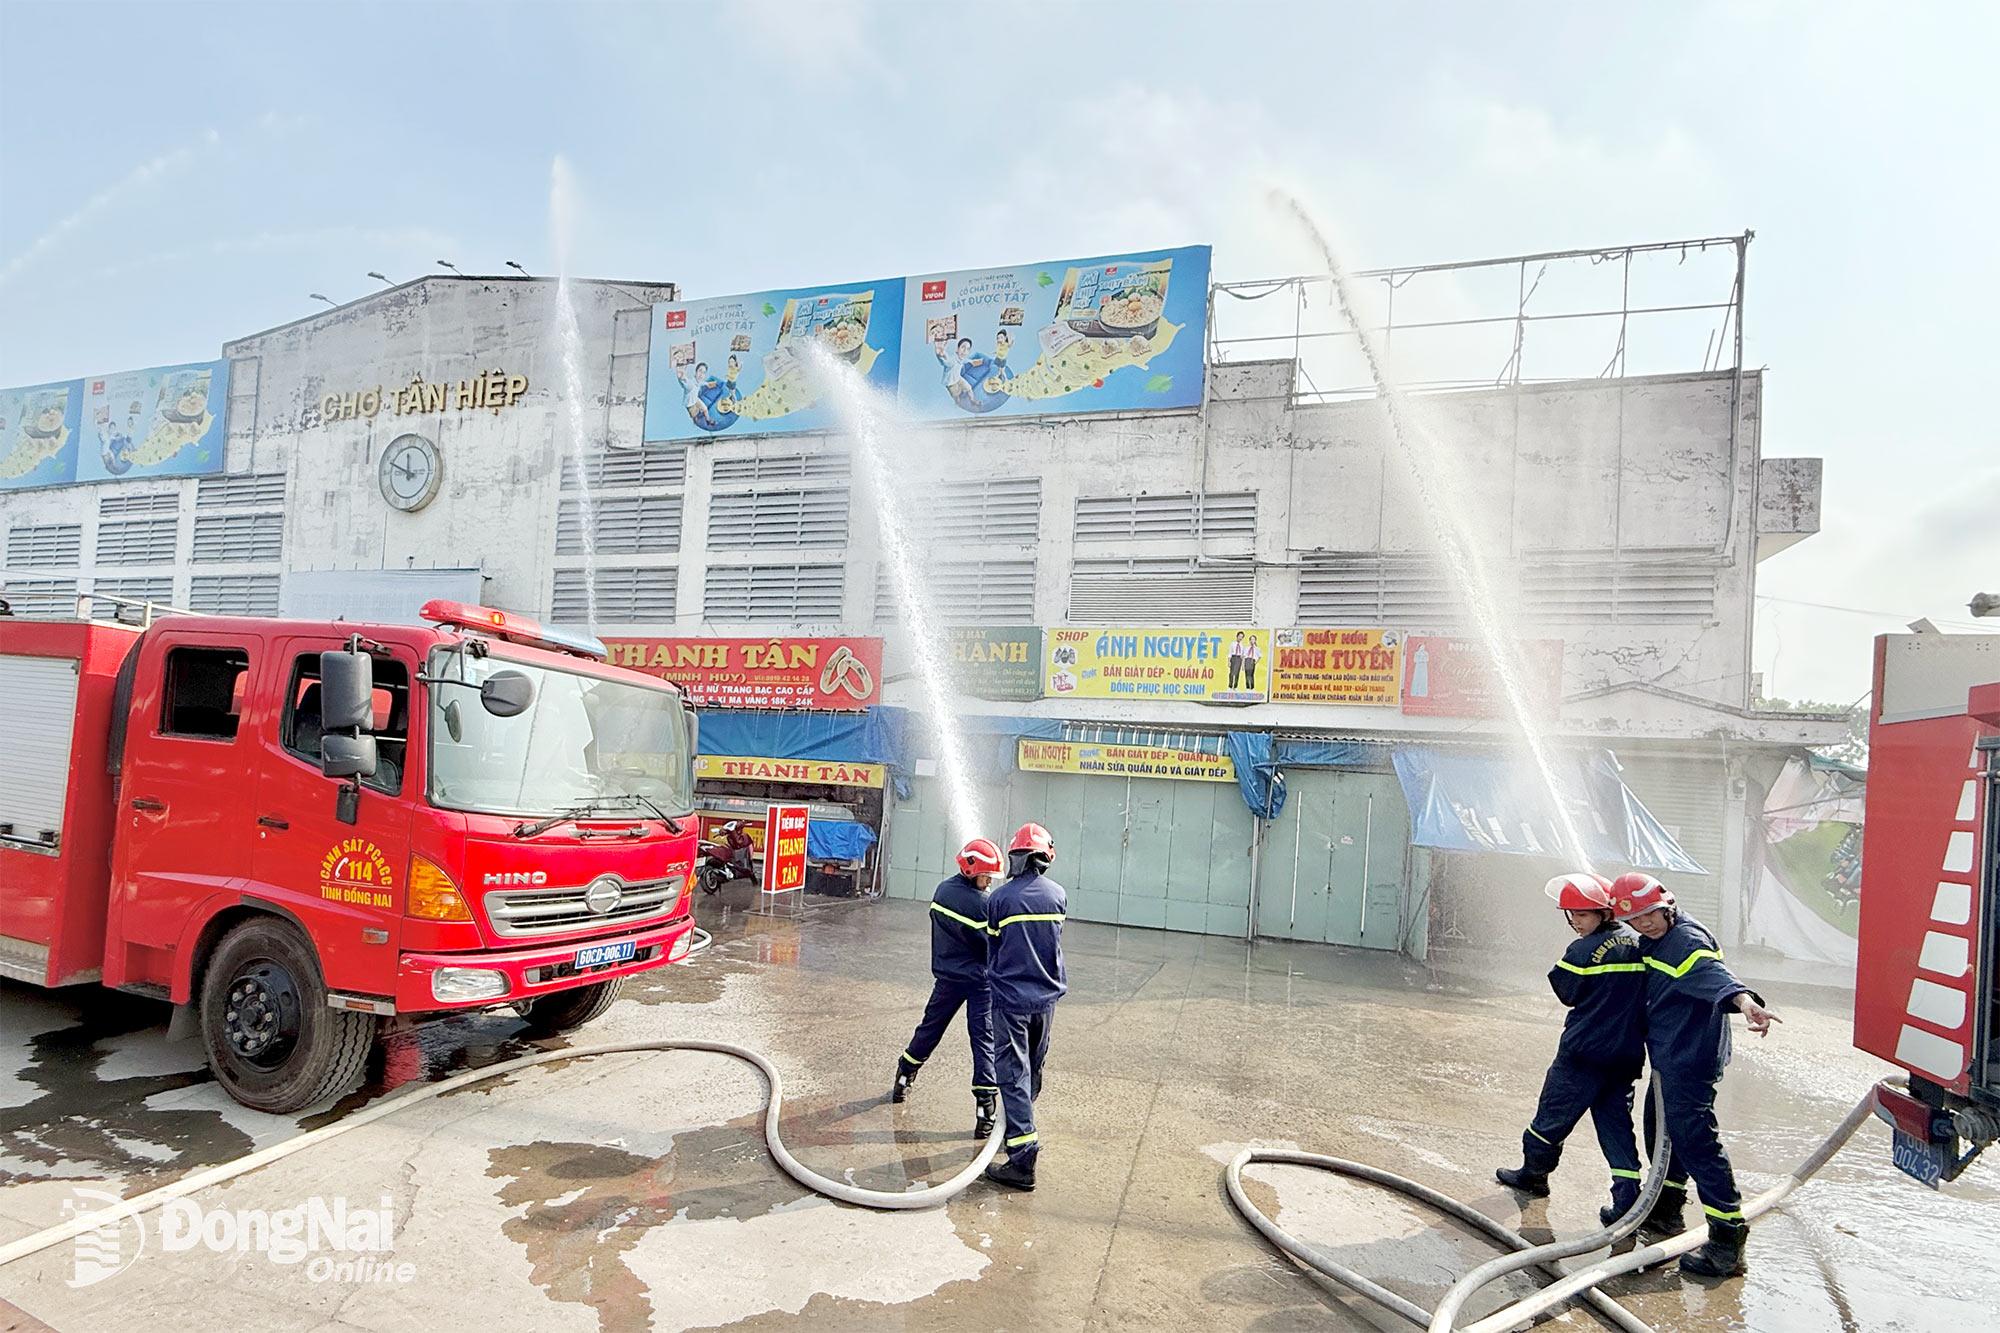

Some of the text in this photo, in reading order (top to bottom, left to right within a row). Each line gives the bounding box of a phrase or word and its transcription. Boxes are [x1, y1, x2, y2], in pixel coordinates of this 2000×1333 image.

[924, 292, 944, 300] VIFON
[391, 372, 447, 416] TÂN
[455, 367, 528, 416] HIỆP
[1056, 631, 1089, 641] SHOP
[604, 638, 820, 669] THANH TÂN
[1096, 631, 1222, 664] ÁNH NGUYỆT
[1280, 648, 1326, 669] MINH
[661, 672, 747, 684] (MINH HUY)
[1104, 664, 1122, 677] BÁN
[1124, 665, 1145, 678] GIÀY
[1147, 665, 1165, 678] DÉP
[1174, 664, 1199, 680] QUẦN
[1201, 666, 1214, 679] ÁO
[722, 686, 753, 694] TRANG
[775, 686, 794, 694] CAO
[1110, 679, 1205, 696] ĐỒNG PHỤC HỌC SINH
[744, 694, 770, 704] VÀNG
[771, 696, 786, 705] 18K
[795, 697, 814, 706] 24K
[1106, 748, 1124, 758] BÁN
[1150, 748, 1168, 761] DÉP
[722, 761, 810, 779] THANH
[817, 764, 871, 784] TÂN
[1080, 760, 1104, 773] NHẬN
[1155, 762, 1166, 775] ÁO
[1170, 763, 1182, 776] VÀ
[1184, 764, 1206, 777] GIÀY
[1208, 764, 1227, 778] DÉP
[779, 838, 805, 856] THANH
[320, 836, 392, 886] CẢNH SÁT PC&CC
[348, 860, 373, 881] 114
[482, 871, 548, 885] HINO
[782, 862, 798, 884] TÂN
[344, 886, 371, 905] ĐỒNG
[374, 892, 392, 908] NAI
[1894, 1144, 1939, 1186] 004.32
